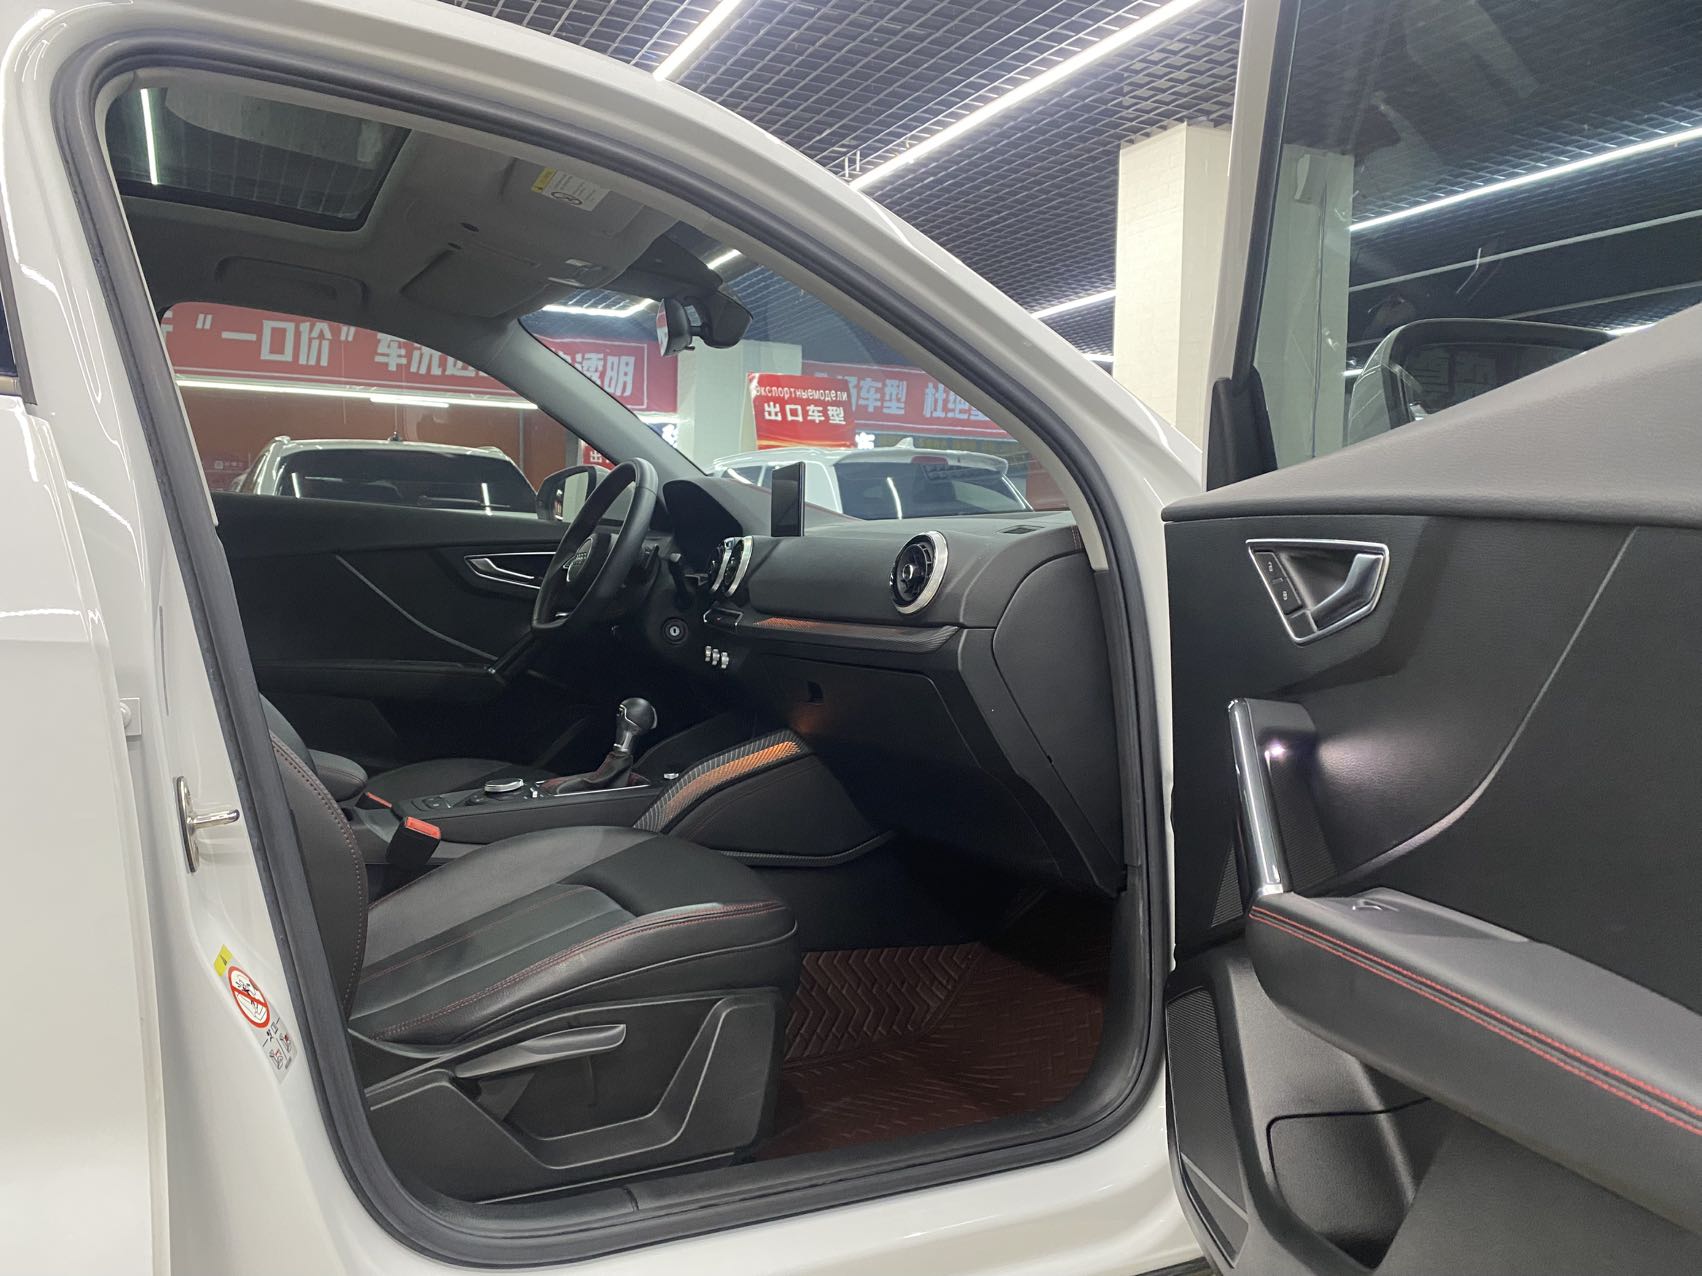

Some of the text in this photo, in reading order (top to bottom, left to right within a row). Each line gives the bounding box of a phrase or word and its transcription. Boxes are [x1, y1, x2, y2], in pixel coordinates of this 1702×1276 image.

[552, 348, 635, 396] 透明
[764, 401, 846, 424] 出口车型
